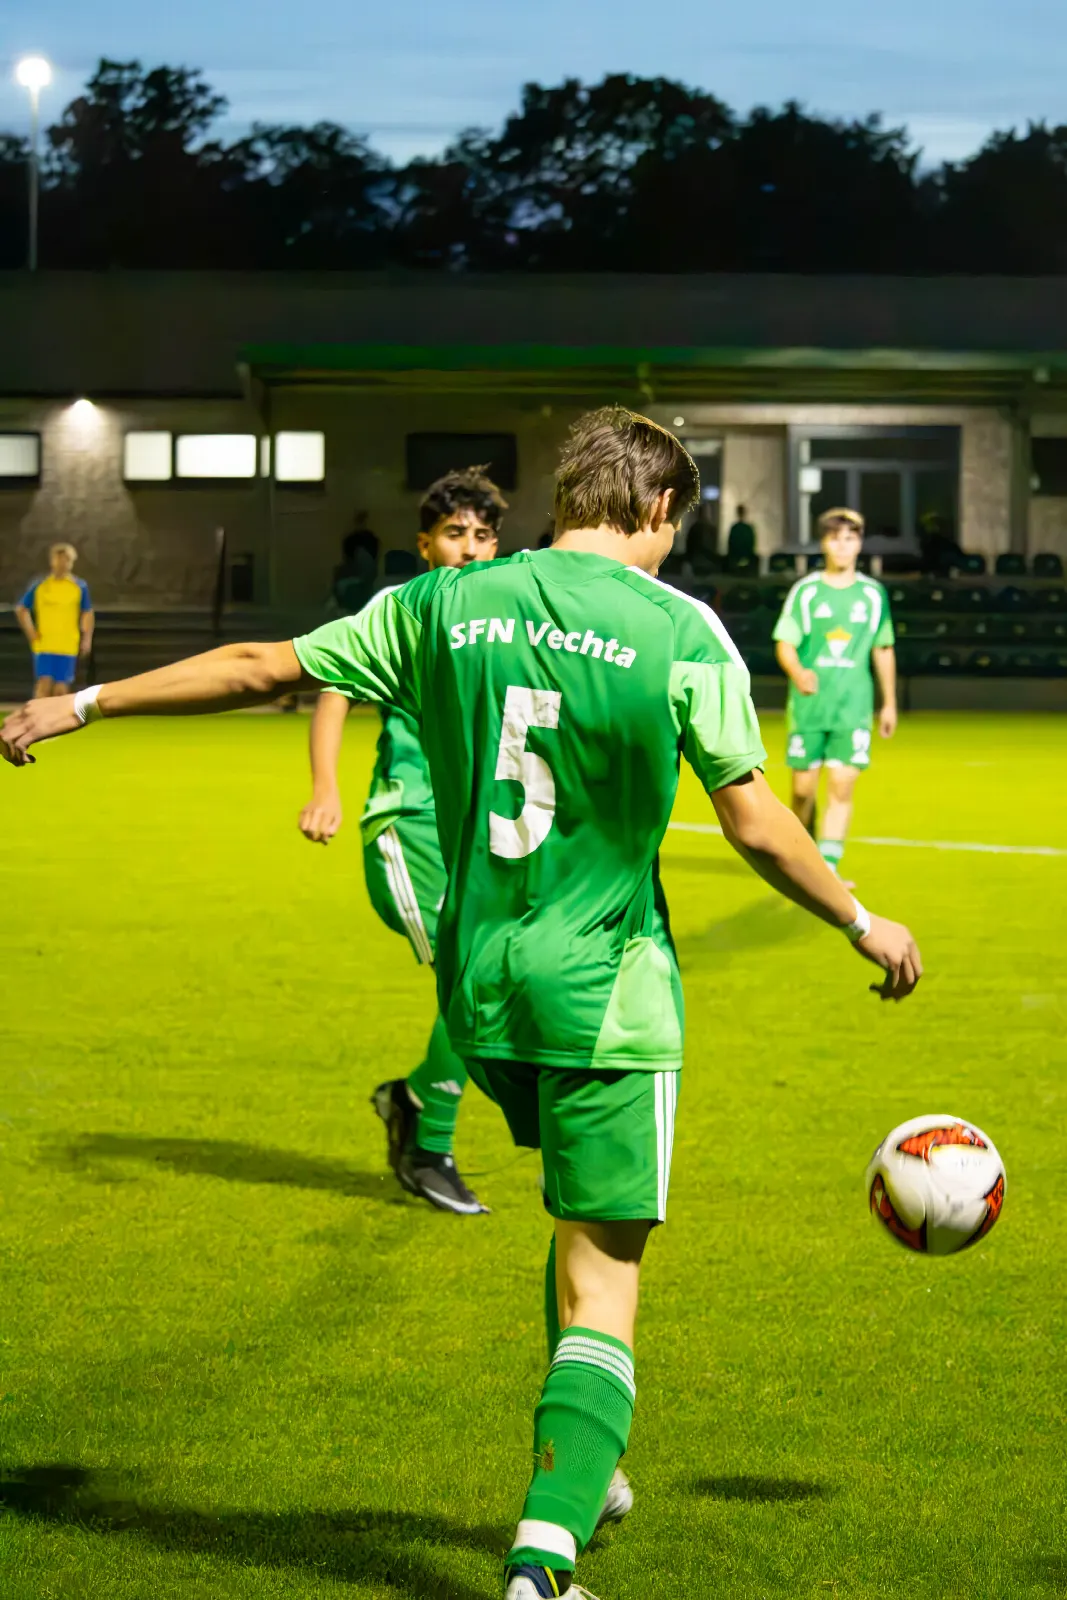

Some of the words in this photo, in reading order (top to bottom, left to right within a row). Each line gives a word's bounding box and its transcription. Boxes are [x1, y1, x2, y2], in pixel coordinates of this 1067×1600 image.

[450, 618, 515, 650] SFN
[526, 620, 637, 669] Vechta
[489, 685, 562, 859] 5
